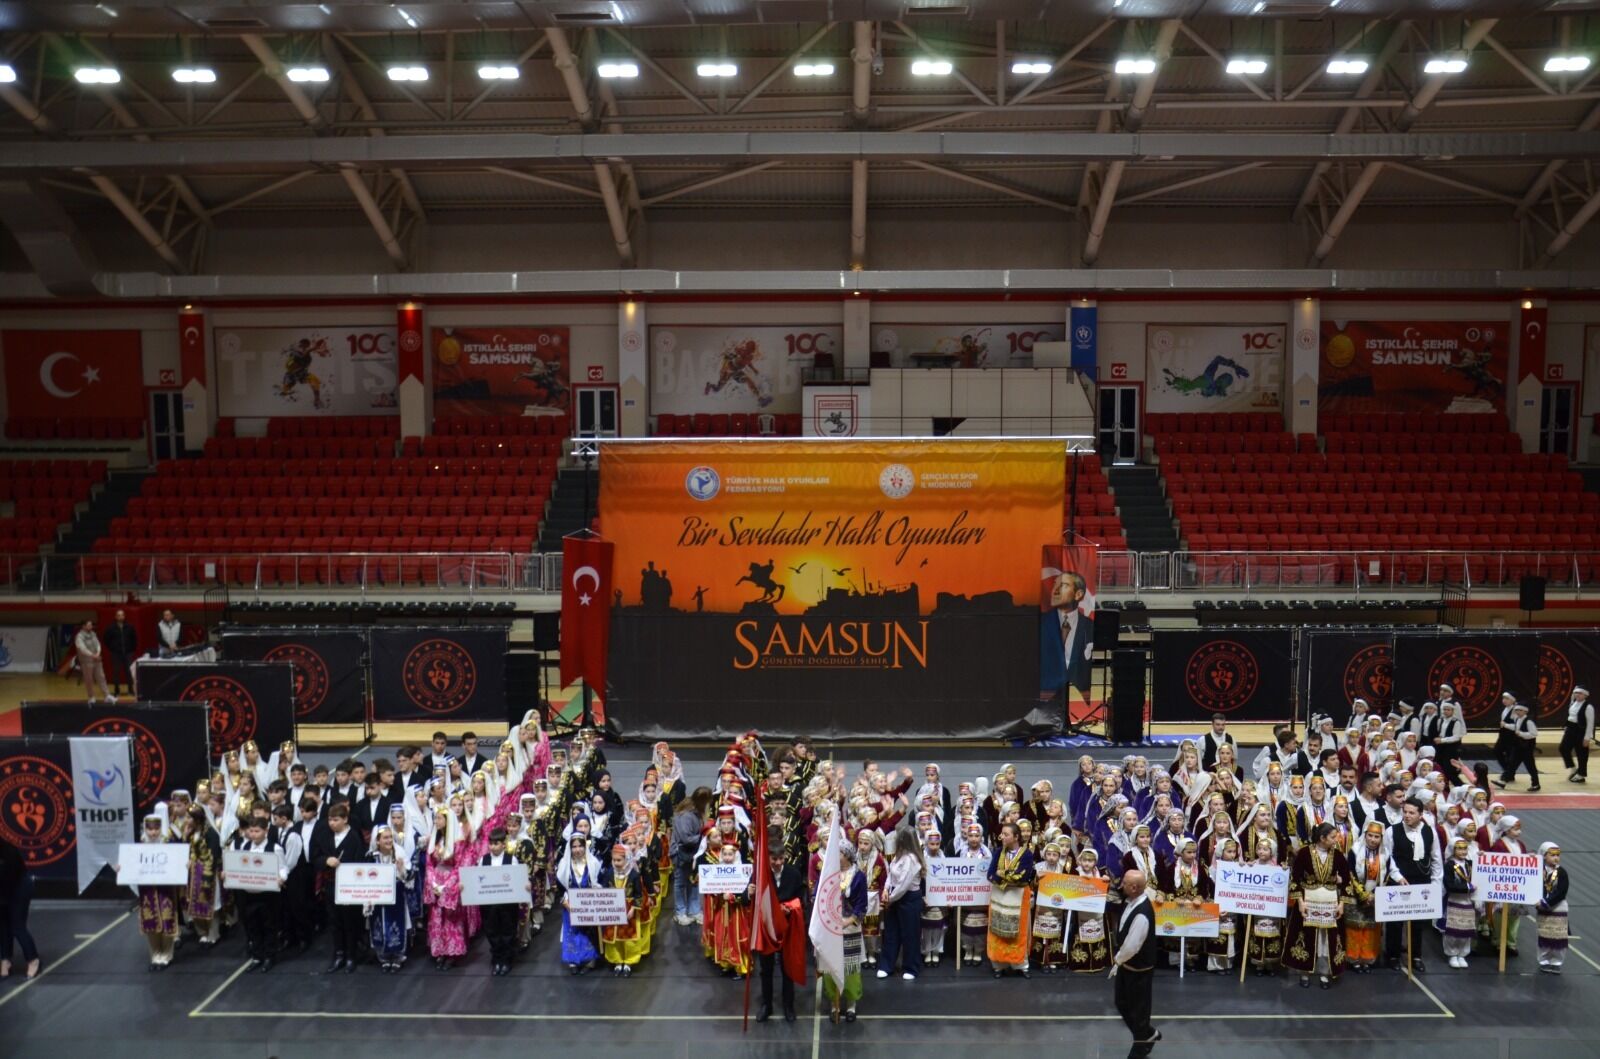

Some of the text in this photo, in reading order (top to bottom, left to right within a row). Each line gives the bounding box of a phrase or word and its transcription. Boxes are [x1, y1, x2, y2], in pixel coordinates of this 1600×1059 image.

[1366, 339, 1458, 351] İSTİKLAL ŞEHRİ
[469, 354, 532, 365] SAMSUN
[1372, 351, 1451, 365] SAMSUN
[588, 369, 603, 379] C3
[1111, 366, 1127, 376] C2
[1548, 367, 1563, 377] C1
[160, 371, 175, 383] C4
[725, 475, 830, 485] TÜRKİYE HALK OYUNLARI
[920, 472, 949, 481] GENÇLİK
[677, 510, 987, 565] Bir Sevdadır Halk Oyunları
[734, 620, 930, 670] SAMSUN
[78, 808, 129, 823] THOF
[1478, 855, 1538, 868] İLKADIM
[716, 866, 737, 874] THOF
[946, 865, 975, 876] THOF
[1477, 866, 1538, 876] HALK OYUNLARI
[1236, 872, 1269, 886] THOF
[1488, 875, 1526, 885] (İLKHOY)
[946, 885, 957, 893] HALK
[1495, 884, 1518, 892] G.S.K
[1218, 890, 1237, 899] ATAKUM
[1237, 891, 1248, 900] HALK
[1265, 893, 1285, 904] MERKEZİ
[1487, 891, 1526, 902] SAMSUN
[1235, 901, 1266, 911] SPOR KULÜBÜ
